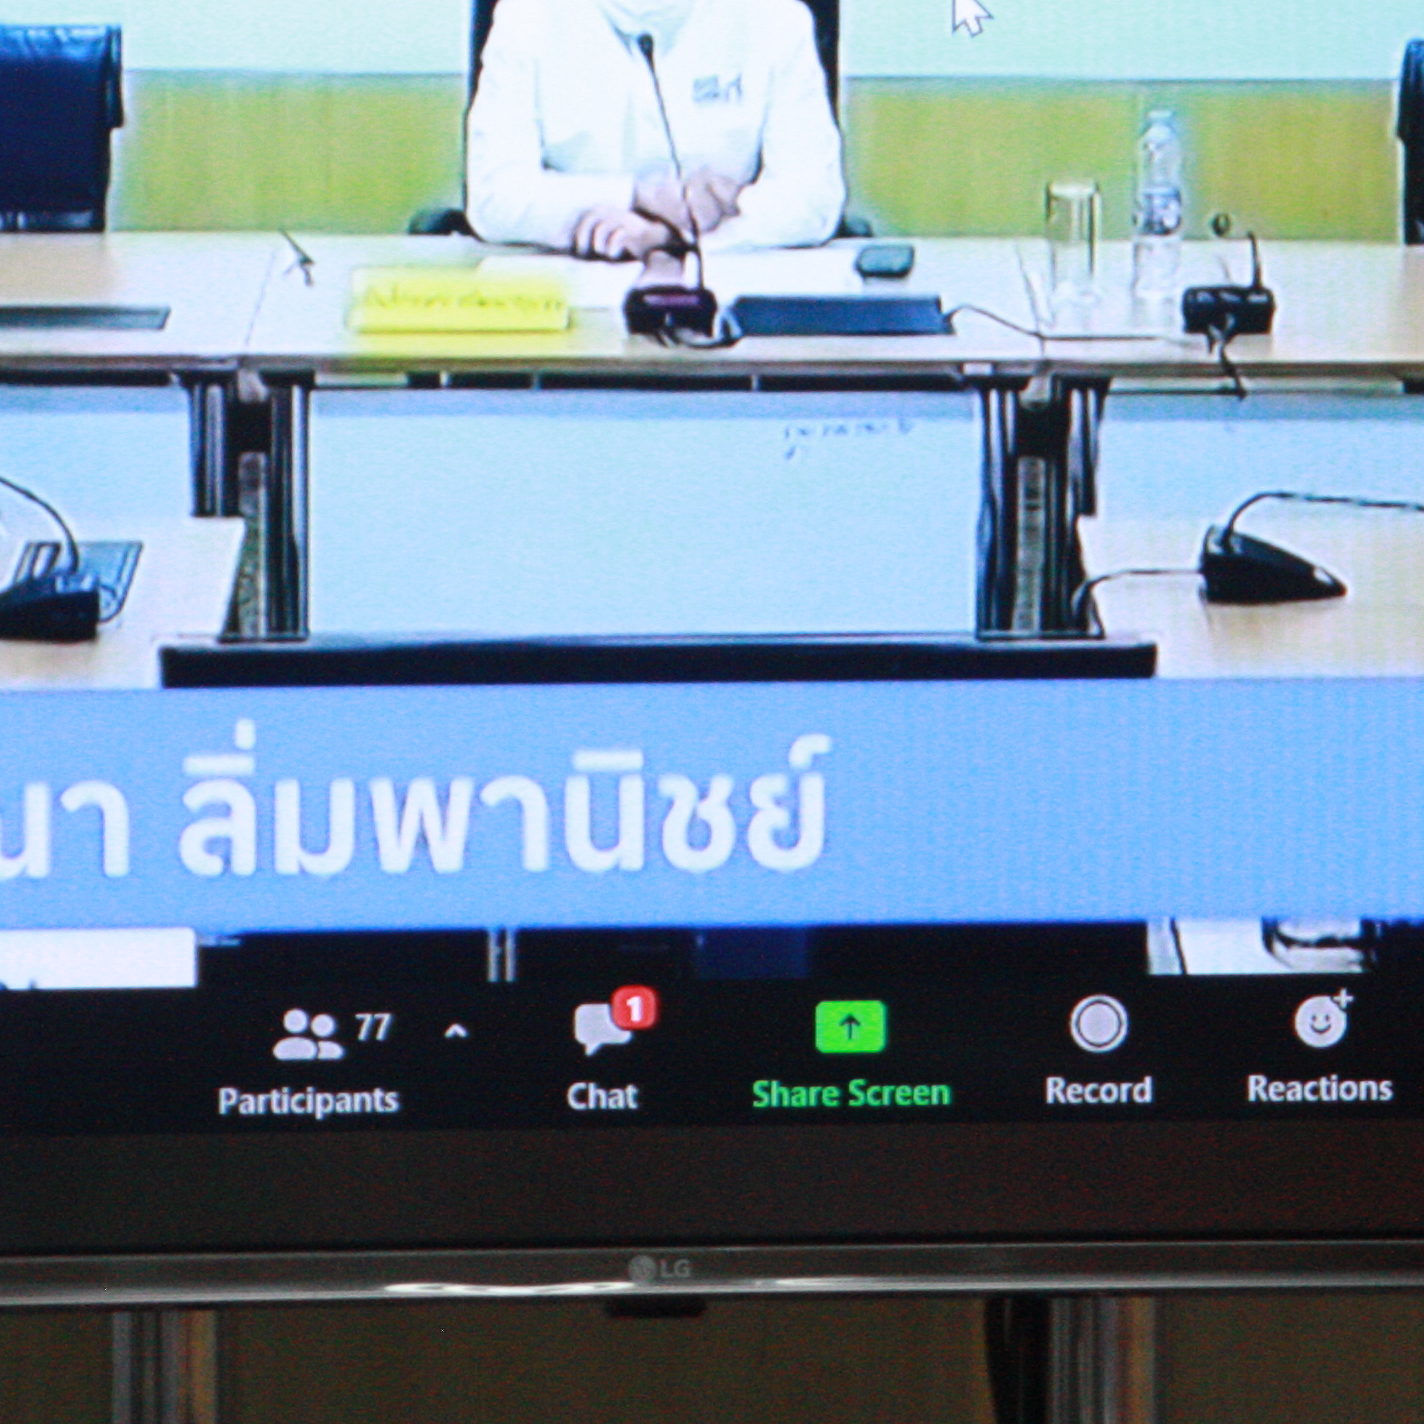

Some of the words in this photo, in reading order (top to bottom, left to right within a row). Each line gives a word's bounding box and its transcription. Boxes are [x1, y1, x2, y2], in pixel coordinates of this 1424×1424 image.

[179, 717, 832, 877] ลิ่มพานิชย์
[626, 995, 643, 1023] 1
[355, 1012, 393, 1042] 77
[567, 1081, 638, 1110] Chat
[752, 1080, 838, 1108] Share
[848, 1078, 951, 1107] Screen
[1045, 1076, 1153, 1104] Record
[1247, 1073, 1393, 1102] Reactions
[218, 1086, 400, 1119] Participants
[661, 1259, 691, 1278] LG
